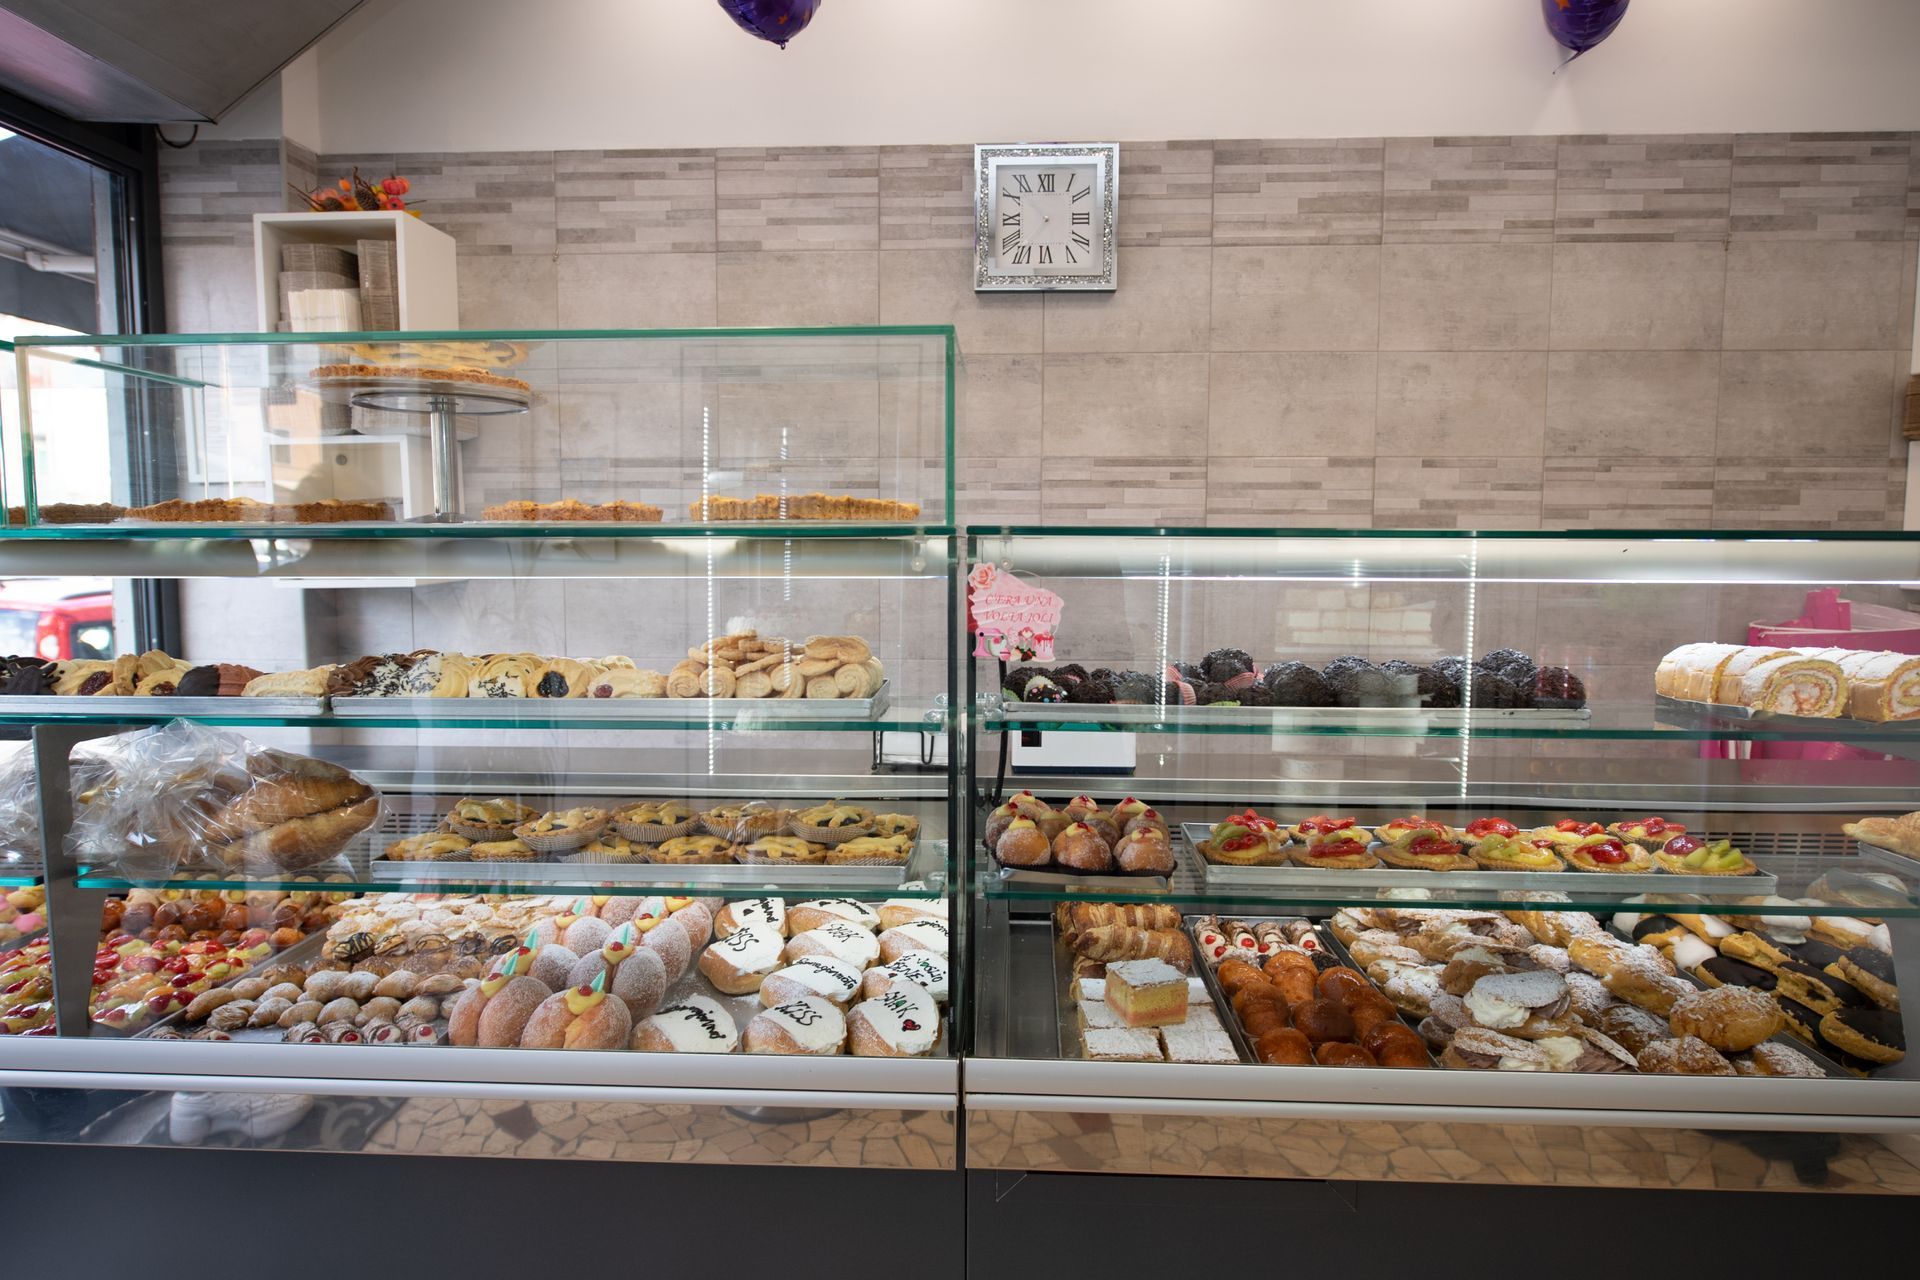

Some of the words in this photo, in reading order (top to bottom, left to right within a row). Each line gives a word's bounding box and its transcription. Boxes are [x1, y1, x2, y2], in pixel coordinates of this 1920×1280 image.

[1011, 174, 1032, 193] XI
[1037, 173, 1056, 193] XII
[1066, 173, 1076, 193] I
[1002, 186, 1021, 206] X
[1071, 185, 1091, 204] II
[1002, 212, 1021, 227] IX
[1071, 211, 1090, 226] III
[1002, 228, 1021, 256] VIII
[1071, 230, 1090, 254] IV
[1011, 245, 1032, 265] VII
[1039, 245, 1053, 264] VI
[1065, 245, 1078, 264] V
[984, 611, 1023, 622] VOLTA
[774, 1000, 822, 1026] KISS
